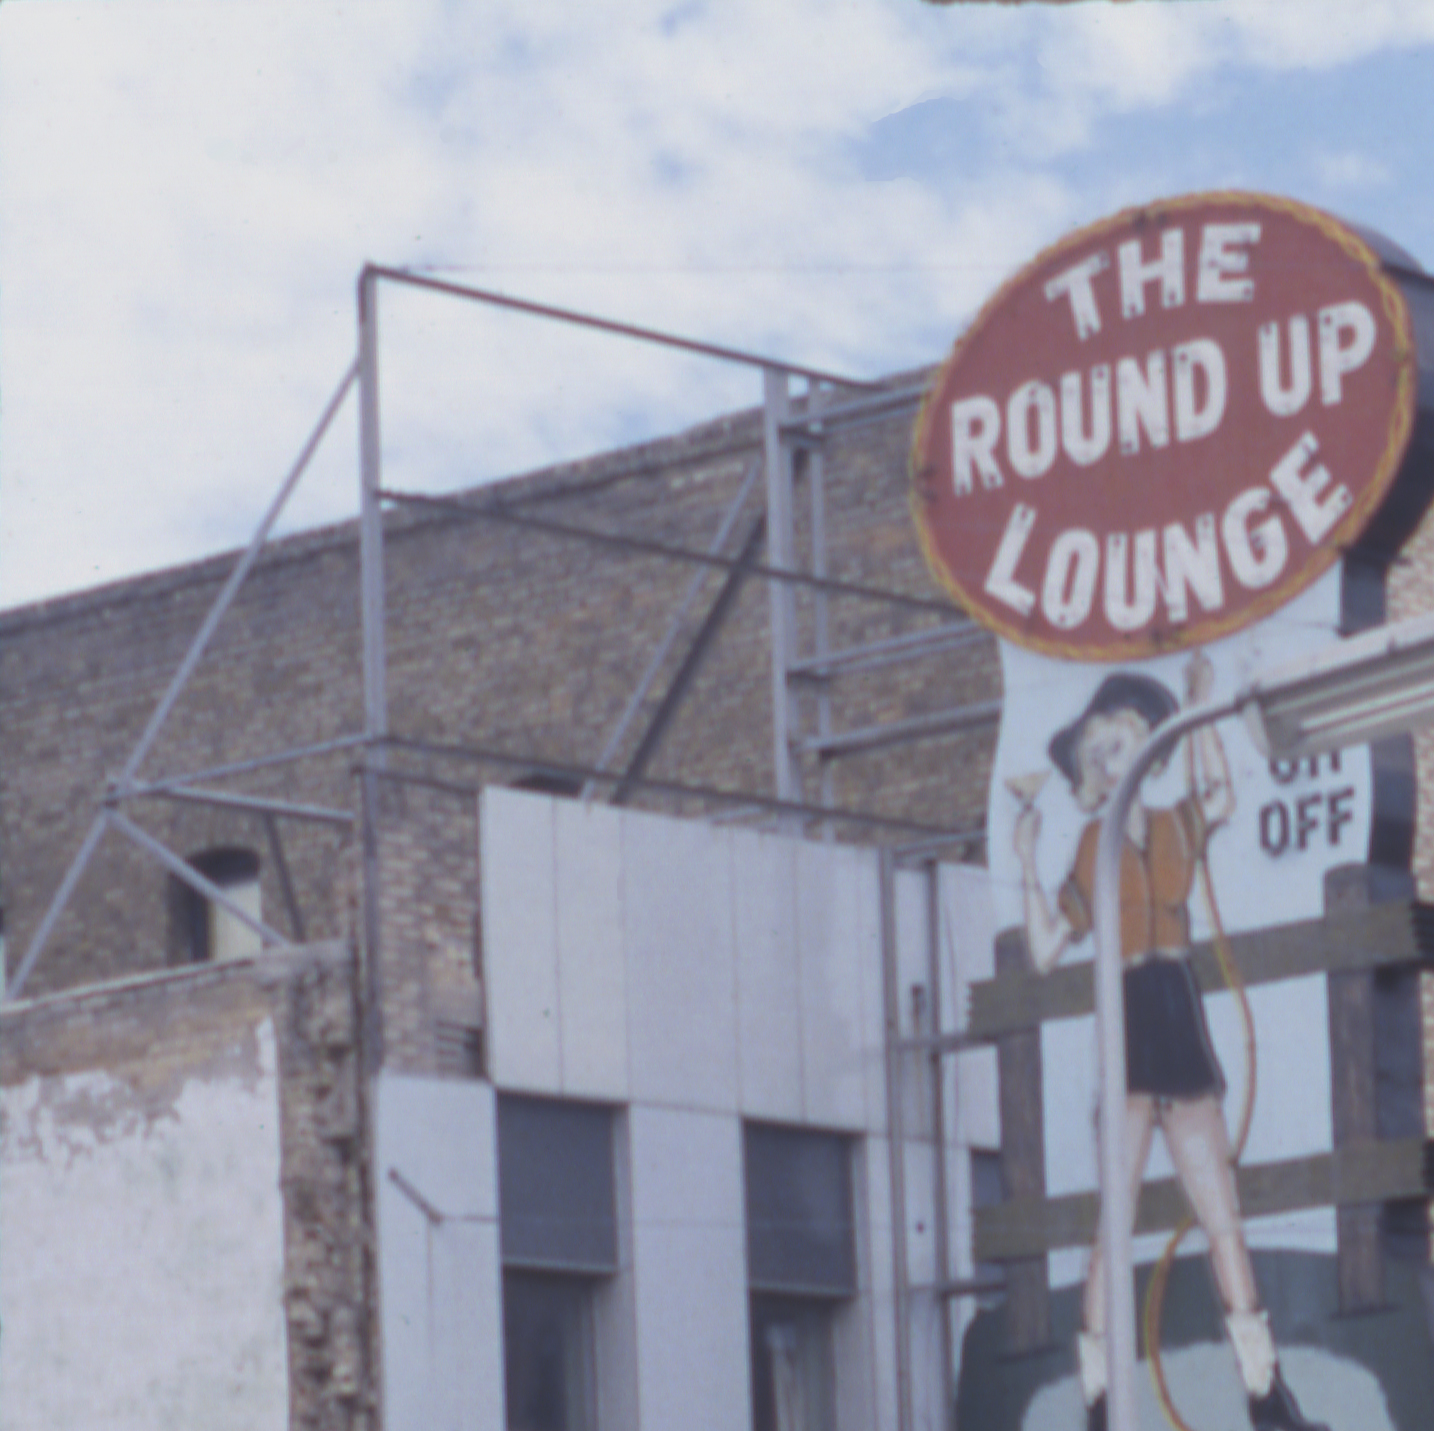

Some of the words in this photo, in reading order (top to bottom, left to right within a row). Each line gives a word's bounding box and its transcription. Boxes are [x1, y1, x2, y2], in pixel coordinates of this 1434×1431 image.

[1043, 221, 1262, 342] THE
[951, 338, 1227, 496] ROUND
[1259, 300, 1377, 417] UP
[984, 431, 1355, 631] LOUNGE
[1258, 786, 1356, 859] OFF
